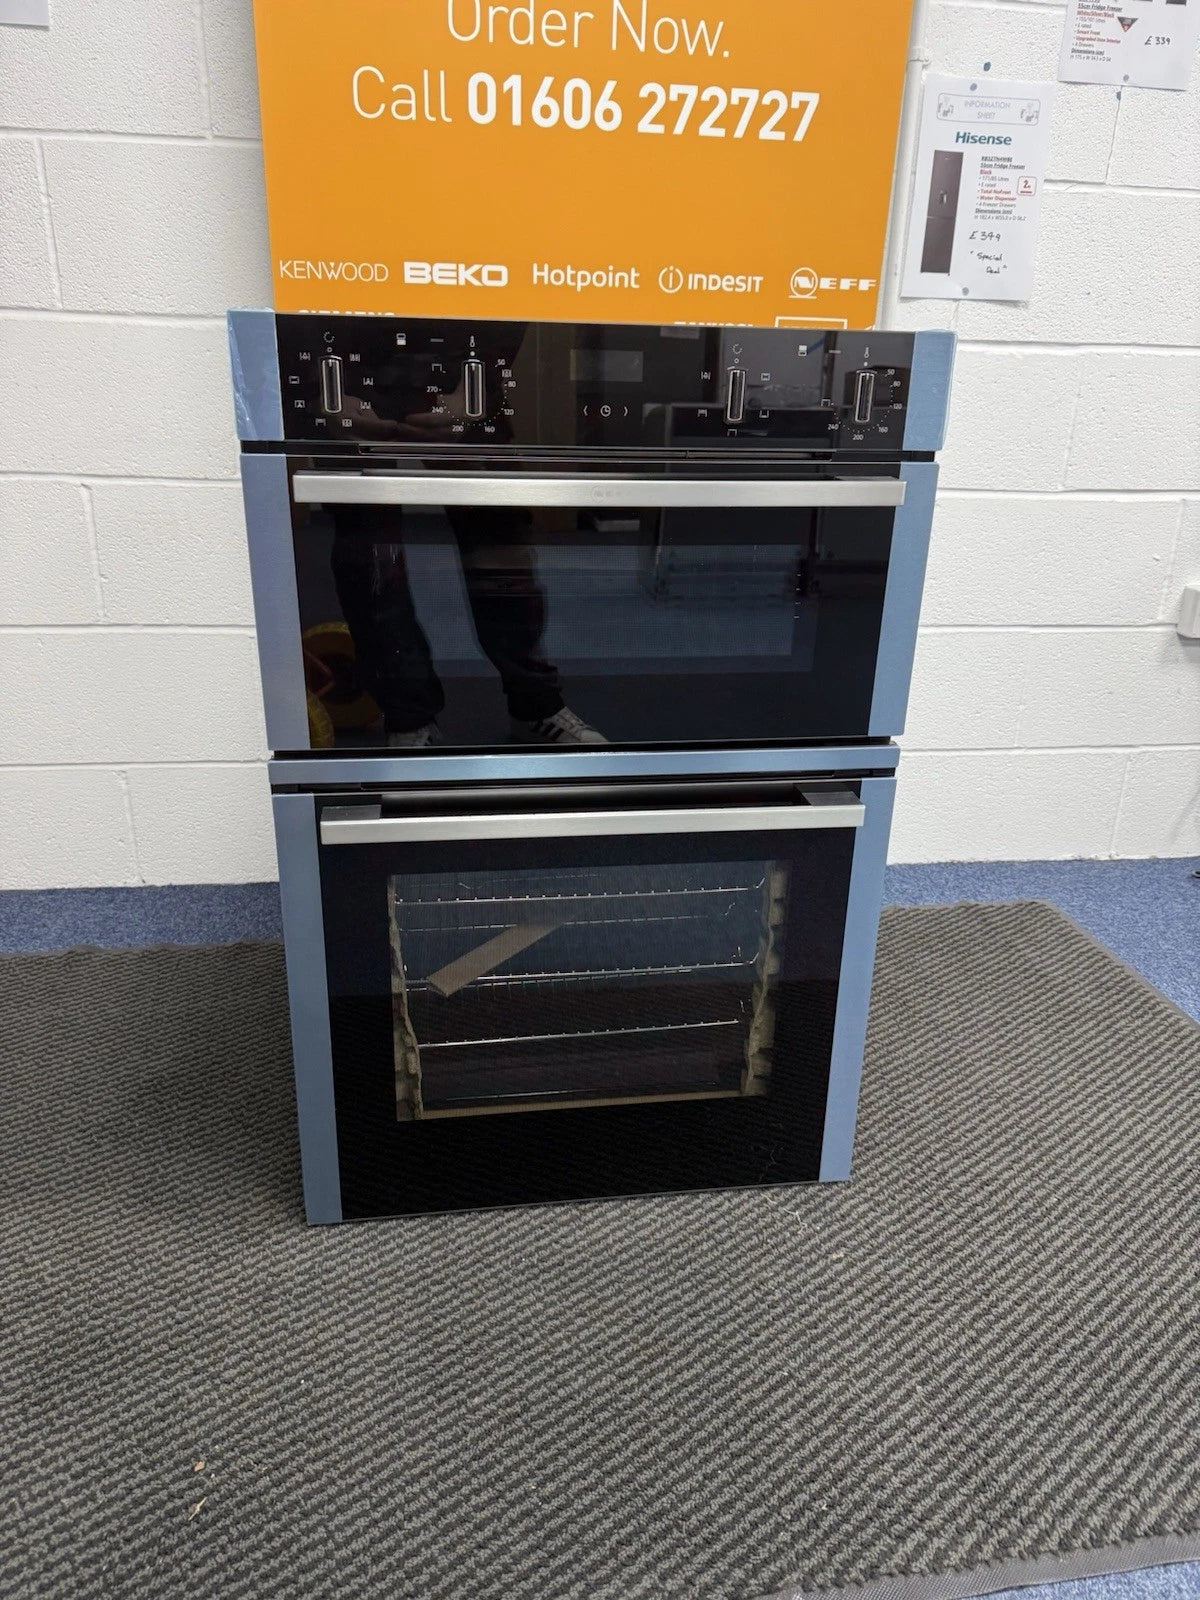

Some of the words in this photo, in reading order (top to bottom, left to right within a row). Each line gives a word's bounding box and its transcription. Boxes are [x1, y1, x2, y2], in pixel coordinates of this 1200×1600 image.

[447, 0, 595, 47] Order
[611, 0, 730, 58] Now.
[352, 65, 453, 123] Call
[467, 71, 623, 132] 01606
[637, 81, 820, 142] 272727
[964, 101, 1011, 109] INFORMATION
[955, 131, 1012, 146] Hisense
[279, 260, 389, 282] KENWOOD
[403, 261, 508, 287] BEKO
[532, 263, 640, 291] Hotpoint
[789, 267, 876, 299] NEFF
